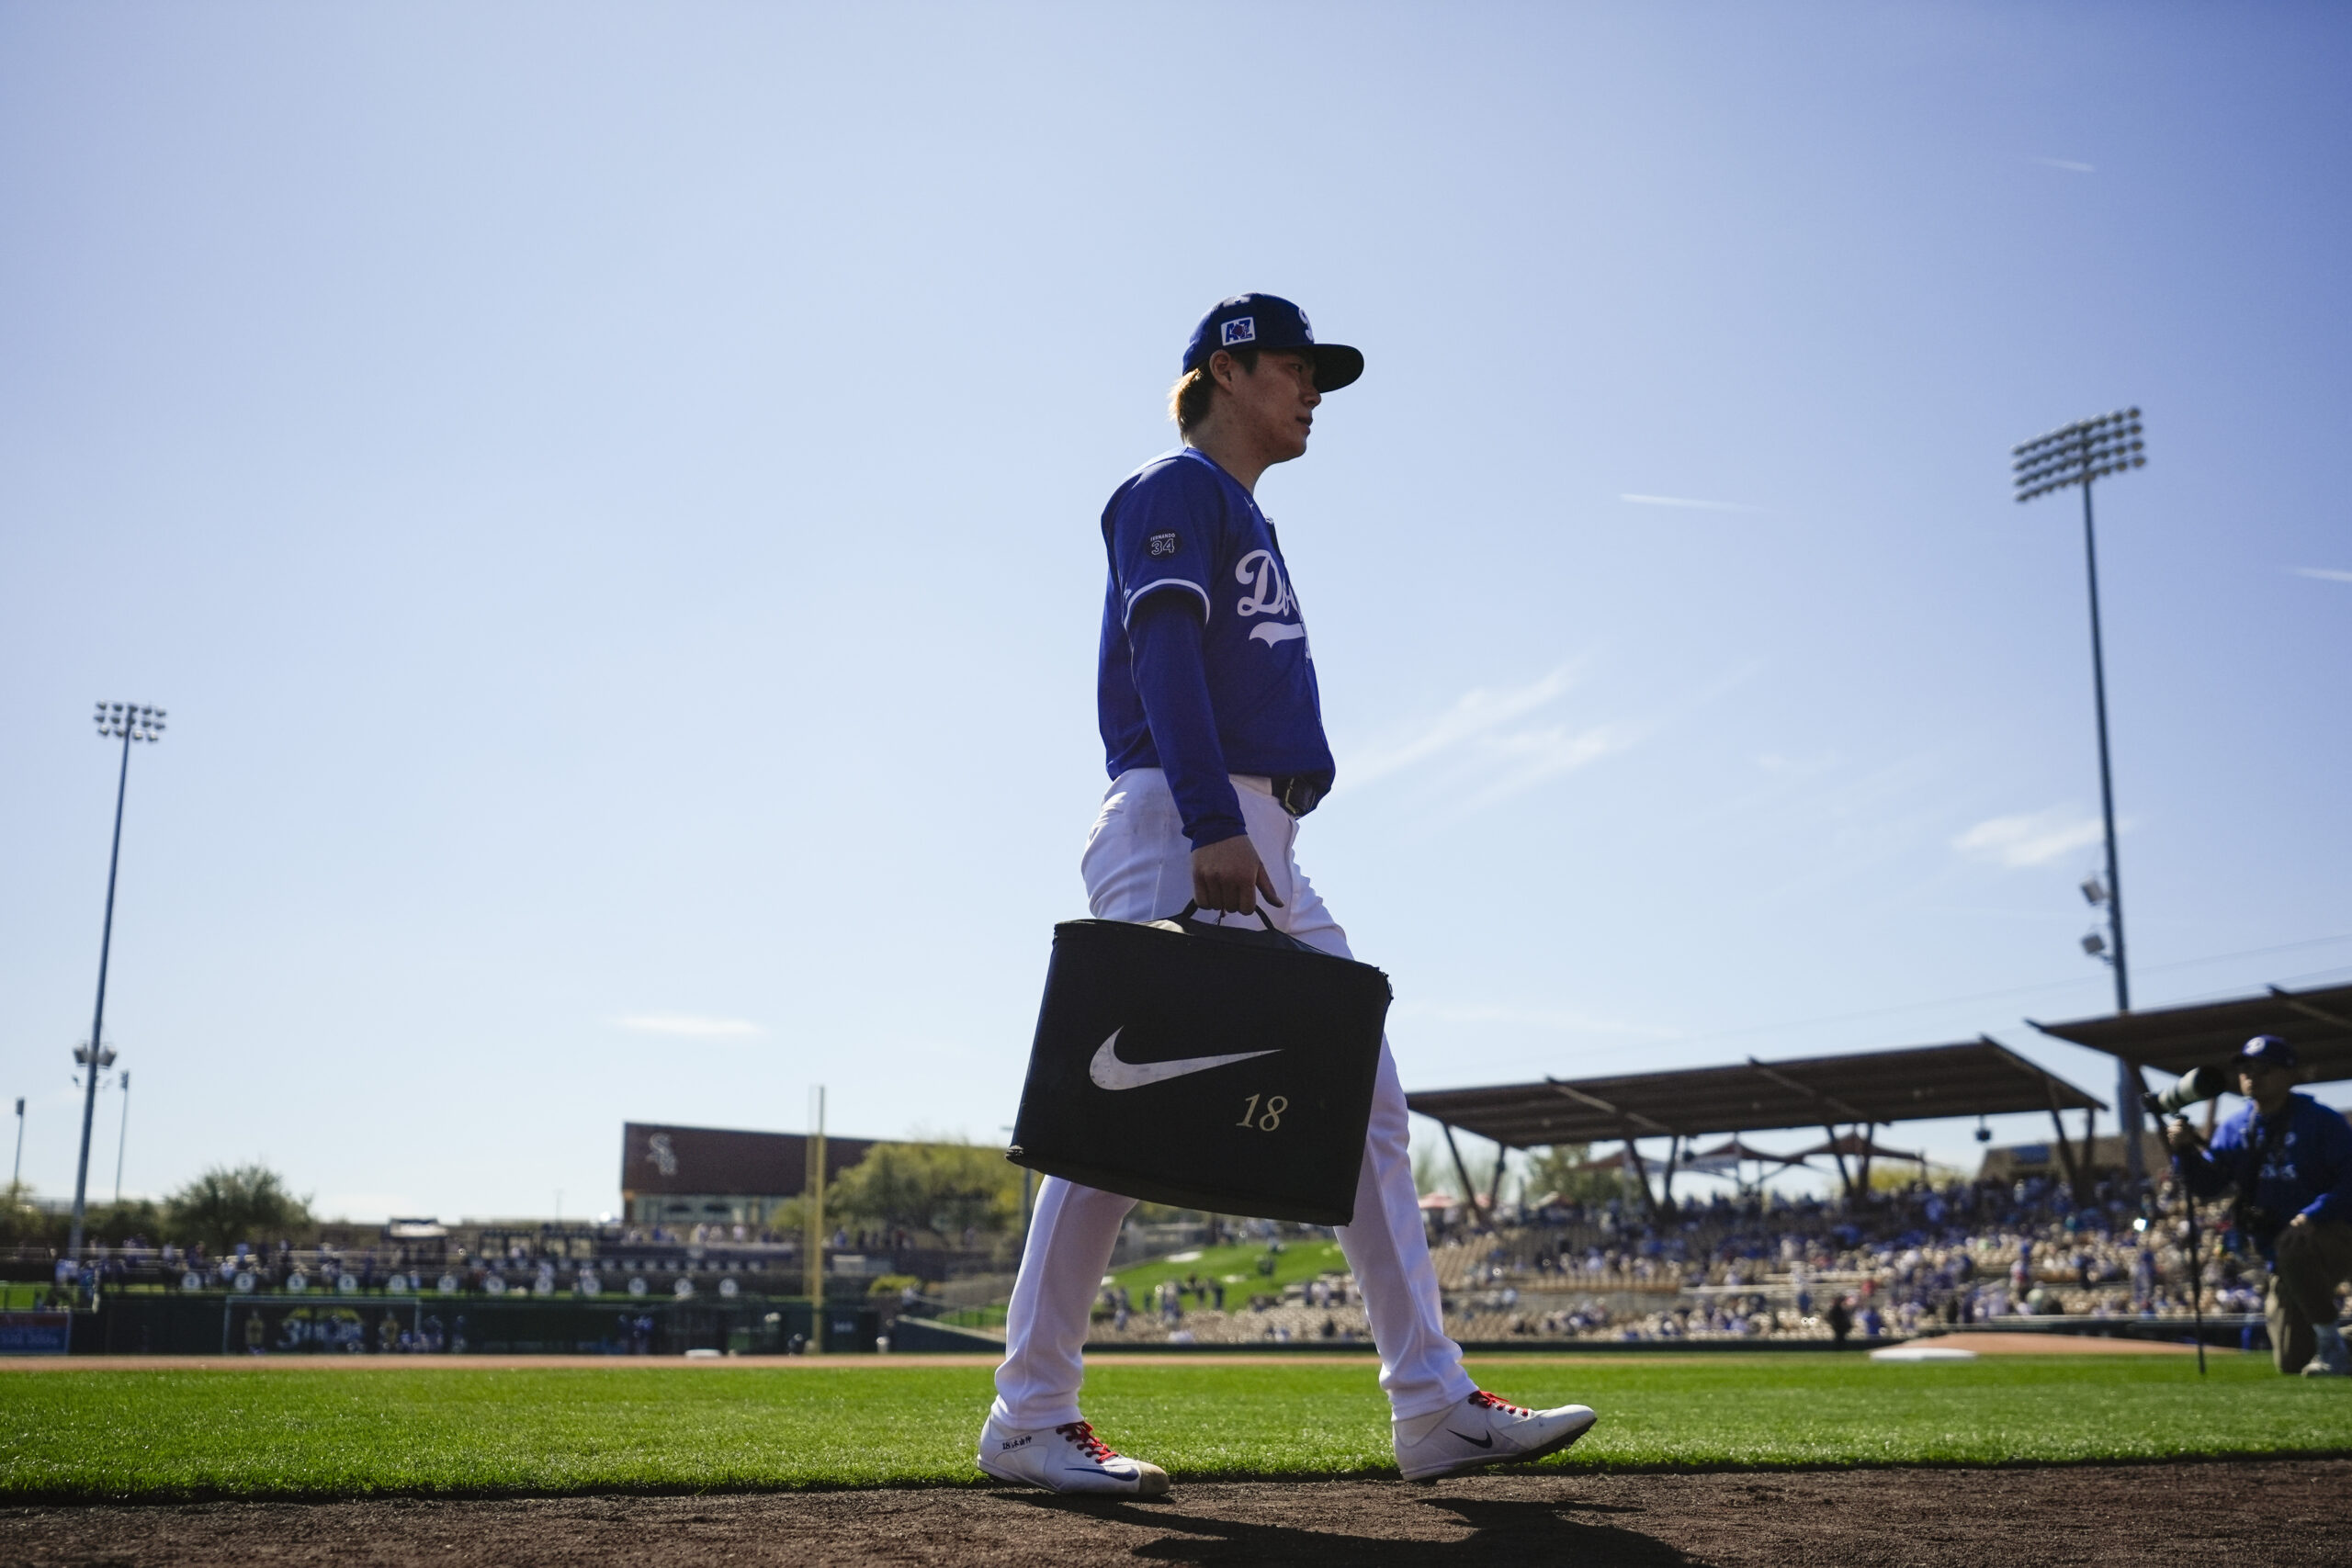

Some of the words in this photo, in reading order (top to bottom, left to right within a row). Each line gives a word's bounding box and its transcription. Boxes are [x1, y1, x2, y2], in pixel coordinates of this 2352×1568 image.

[1226, 319, 1253, 343] AZ
[1149, 533, 1176, 542] FERNANDO
[1151, 538, 1175, 556] 34
[1236, 1093, 1288, 1132] 18
